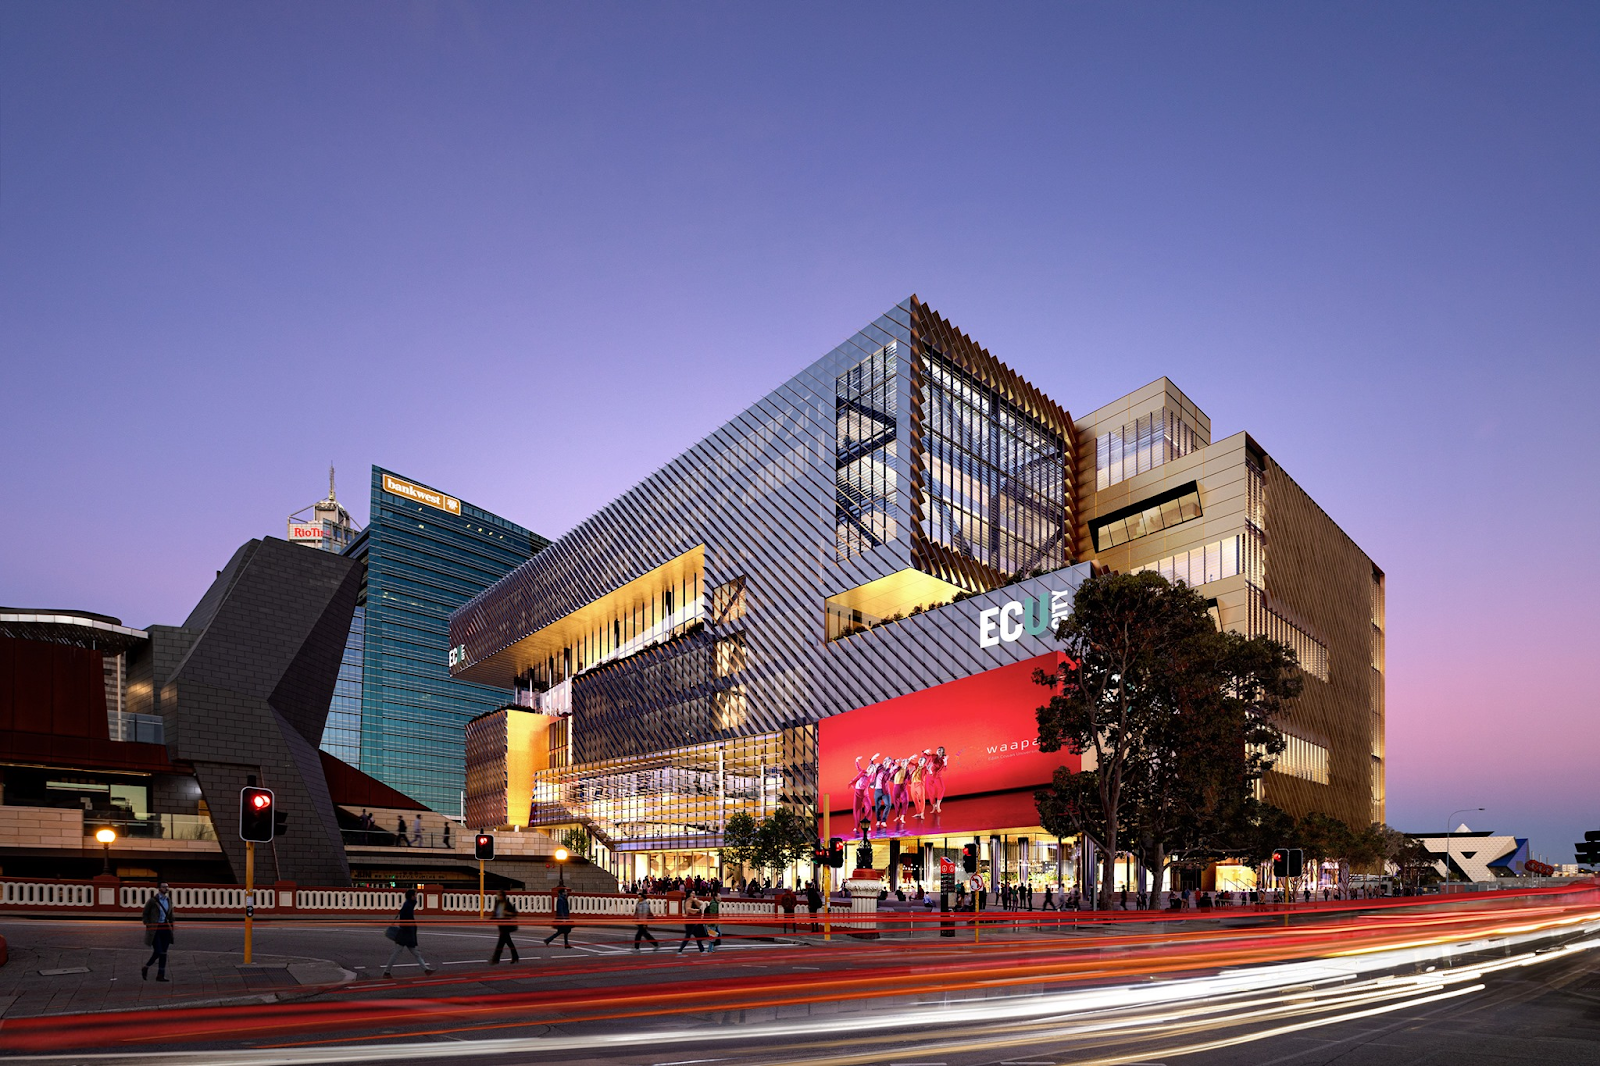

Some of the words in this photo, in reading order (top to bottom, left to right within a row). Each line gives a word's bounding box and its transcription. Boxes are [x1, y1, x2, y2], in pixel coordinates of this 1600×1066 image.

[387, 478, 441, 505] bankwest
[980, 592, 1049, 648] ECU
[1051, 590, 1068, 630] CITY
[986, 738, 1041, 754] waapa
